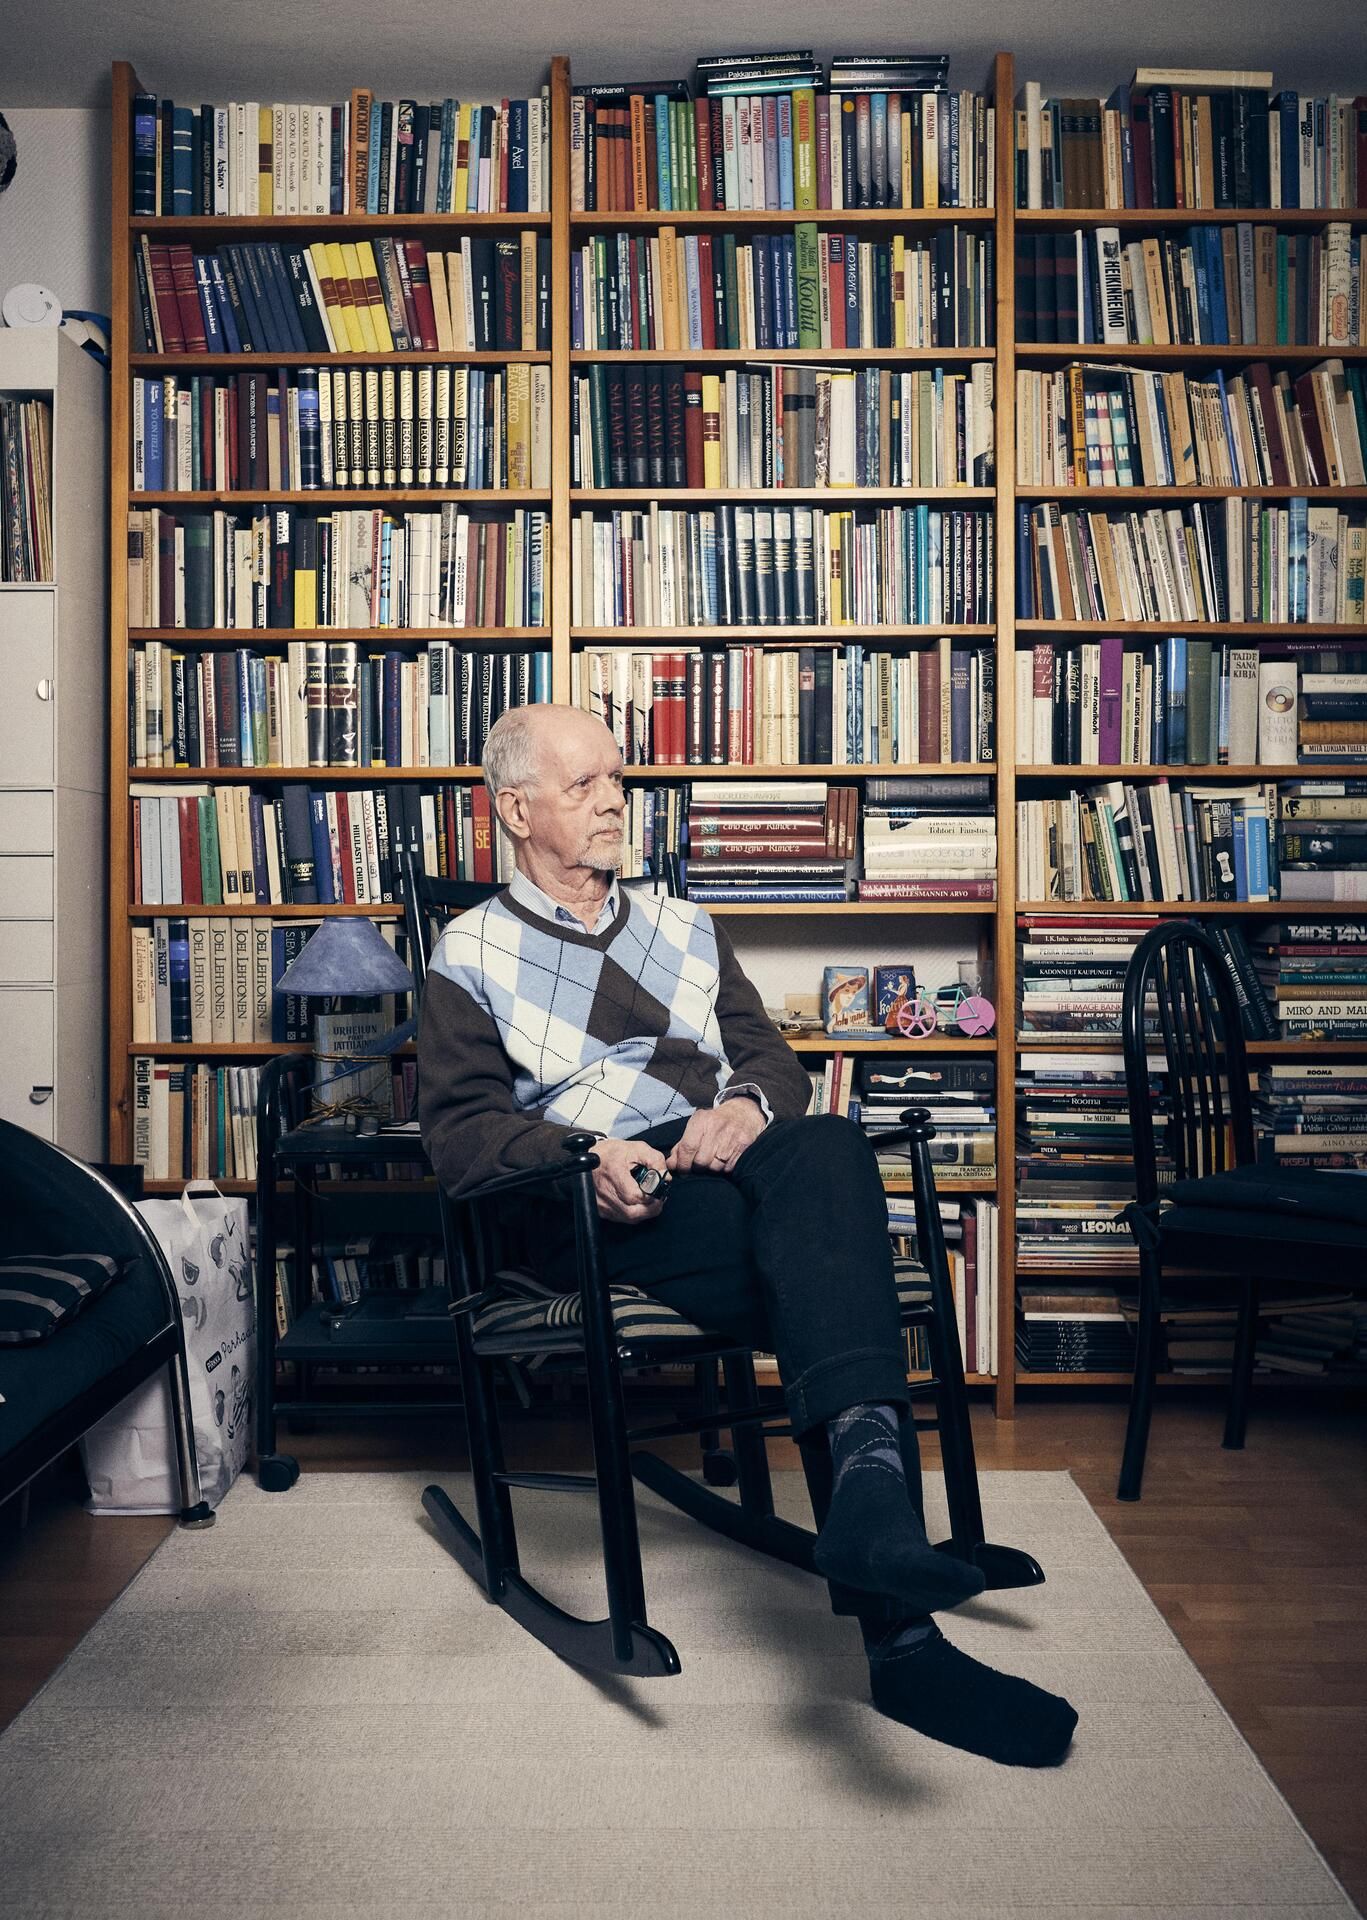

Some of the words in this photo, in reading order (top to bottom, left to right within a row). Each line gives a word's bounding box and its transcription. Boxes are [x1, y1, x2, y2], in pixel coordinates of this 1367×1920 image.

[356, 95, 369, 143] BOCCACCIO
[532, 104, 539, 115] BO
[573, 99, 583, 110] 12
[768, 102, 778, 138] PAKKANEN
[781, 103, 790, 138] PAKKANEN
[531, 117, 539, 156] CARPELAN
[572, 112, 584, 150] novellia
[725, 117, 734, 151] PAKKANEN
[740, 112, 750, 145] PAKKANEN
[753, 108, 762, 144] PAKKANEN
[860, 113, 869, 148] Pakkanen
[891, 113, 899, 147] Pakkanen
[926, 105, 935, 139] PAKKANEN
[942, 115, 950, 149] Pakkanen
[217, 158, 227, 189] Asimov
[380, 147, 389, 190] FAHRENHEIT
[512, 146, 524, 169] Axel
[354, 150, 369, 209] DECAMERONE
[380, 193, 388, 205] 451
[799, 276, 818, 333] Kootut
[1105, 261, 1124, 327] HEIKINHEIMO
[164, 378, 177, 419] nobel
[509, 366, 519, 423] HAAVIKKO
[518, 366, 529, 400] PAAVO
[1073, 372, 1084, 408] Vangittu
[151, 408, 158, 418] YÖ
[152, 420, 158, 431] ON
[610, 384, 622, 448] SALAMA
[630, 384, 642, 448] SALAMA
[649, 384, 660, 449] SALAMA
[670, 384, 681, 447] SALAMA
[1076, 410, 1085, 433] mieli
[337, 423, 346, 467] TEOKSET
[353, 423, 362, 465] TEOKSET
[369, 423, 378, 466] TEOKSET
[385, 423, 395, 466] TEOKSET
[401, 422, 411, 466] TEOKSET
[420, 423, 429, 466] TEOKSET
[437, 423, 447, 466] TEOKSET
[455, 422, 464, 465] TEOKSET
[357, 516, 366, 549] nobel
[221, 655, 229, 679] OLLI
[982, 653, 993, 686] WELLS
[1232, 653, 1257, 661] TAIDE
[881, 658, 889, 692] maailma
[1091, 677, 1099, 697] pentti
[221, 681, 231, 730] JALONEN
[881, 693, 889, 727] uutena
[1134, 717, 1139, 725] ON
[890, 785, 975, 796] saarikoski
[376, 795, 388, 840] KOEPPEN
[928, 826, 957, 834] Tohtori
[959, 826, 988, 835] Faustus
[352, 824, 363, 863] HIILILASTI
[354, 867, 365, 899] CHILEEN
[191, 929, 206, 955] JOEL
[212, 929, 226, 955] JOEL
[235, 929, 248, 955] JOEL
[255, 929, 267, 955] JOEL
[1288, 925, 1332, 942] TAIDE
[194, 957, 206, 1019] LEHTONEN
[214, 957, 227, 1019] LEHTONEN
[236, 957, 250, 1019] LEHTONEN
[257, 957, 269, 1019] LEHTONEN
[1245, 964, 1261, 995] PENTTI
[1257, 997, 1275, 1034] LINKOLA
[1096, 1003, 1122, 1011] BANK
[1286, 1005, 1313, 1016] MIRÓ
[1319, 1007, 1342, 1016] AND
[1289, 1020, 1306, 1029] Great
[1308, 1020, 1329, 1029] Dutch
[1329, 1020, 1358, 1029] Paintings
[333, 1041, 374, 1051] JÄTTILÄIN
[135, 1060, 150, 1083] Veijo
[137, 1085, 151, 1108] Meri
[1071, 1097, 1100, 1105] Rooma
[136, 1117, 150, 1159] NOVELLIT
